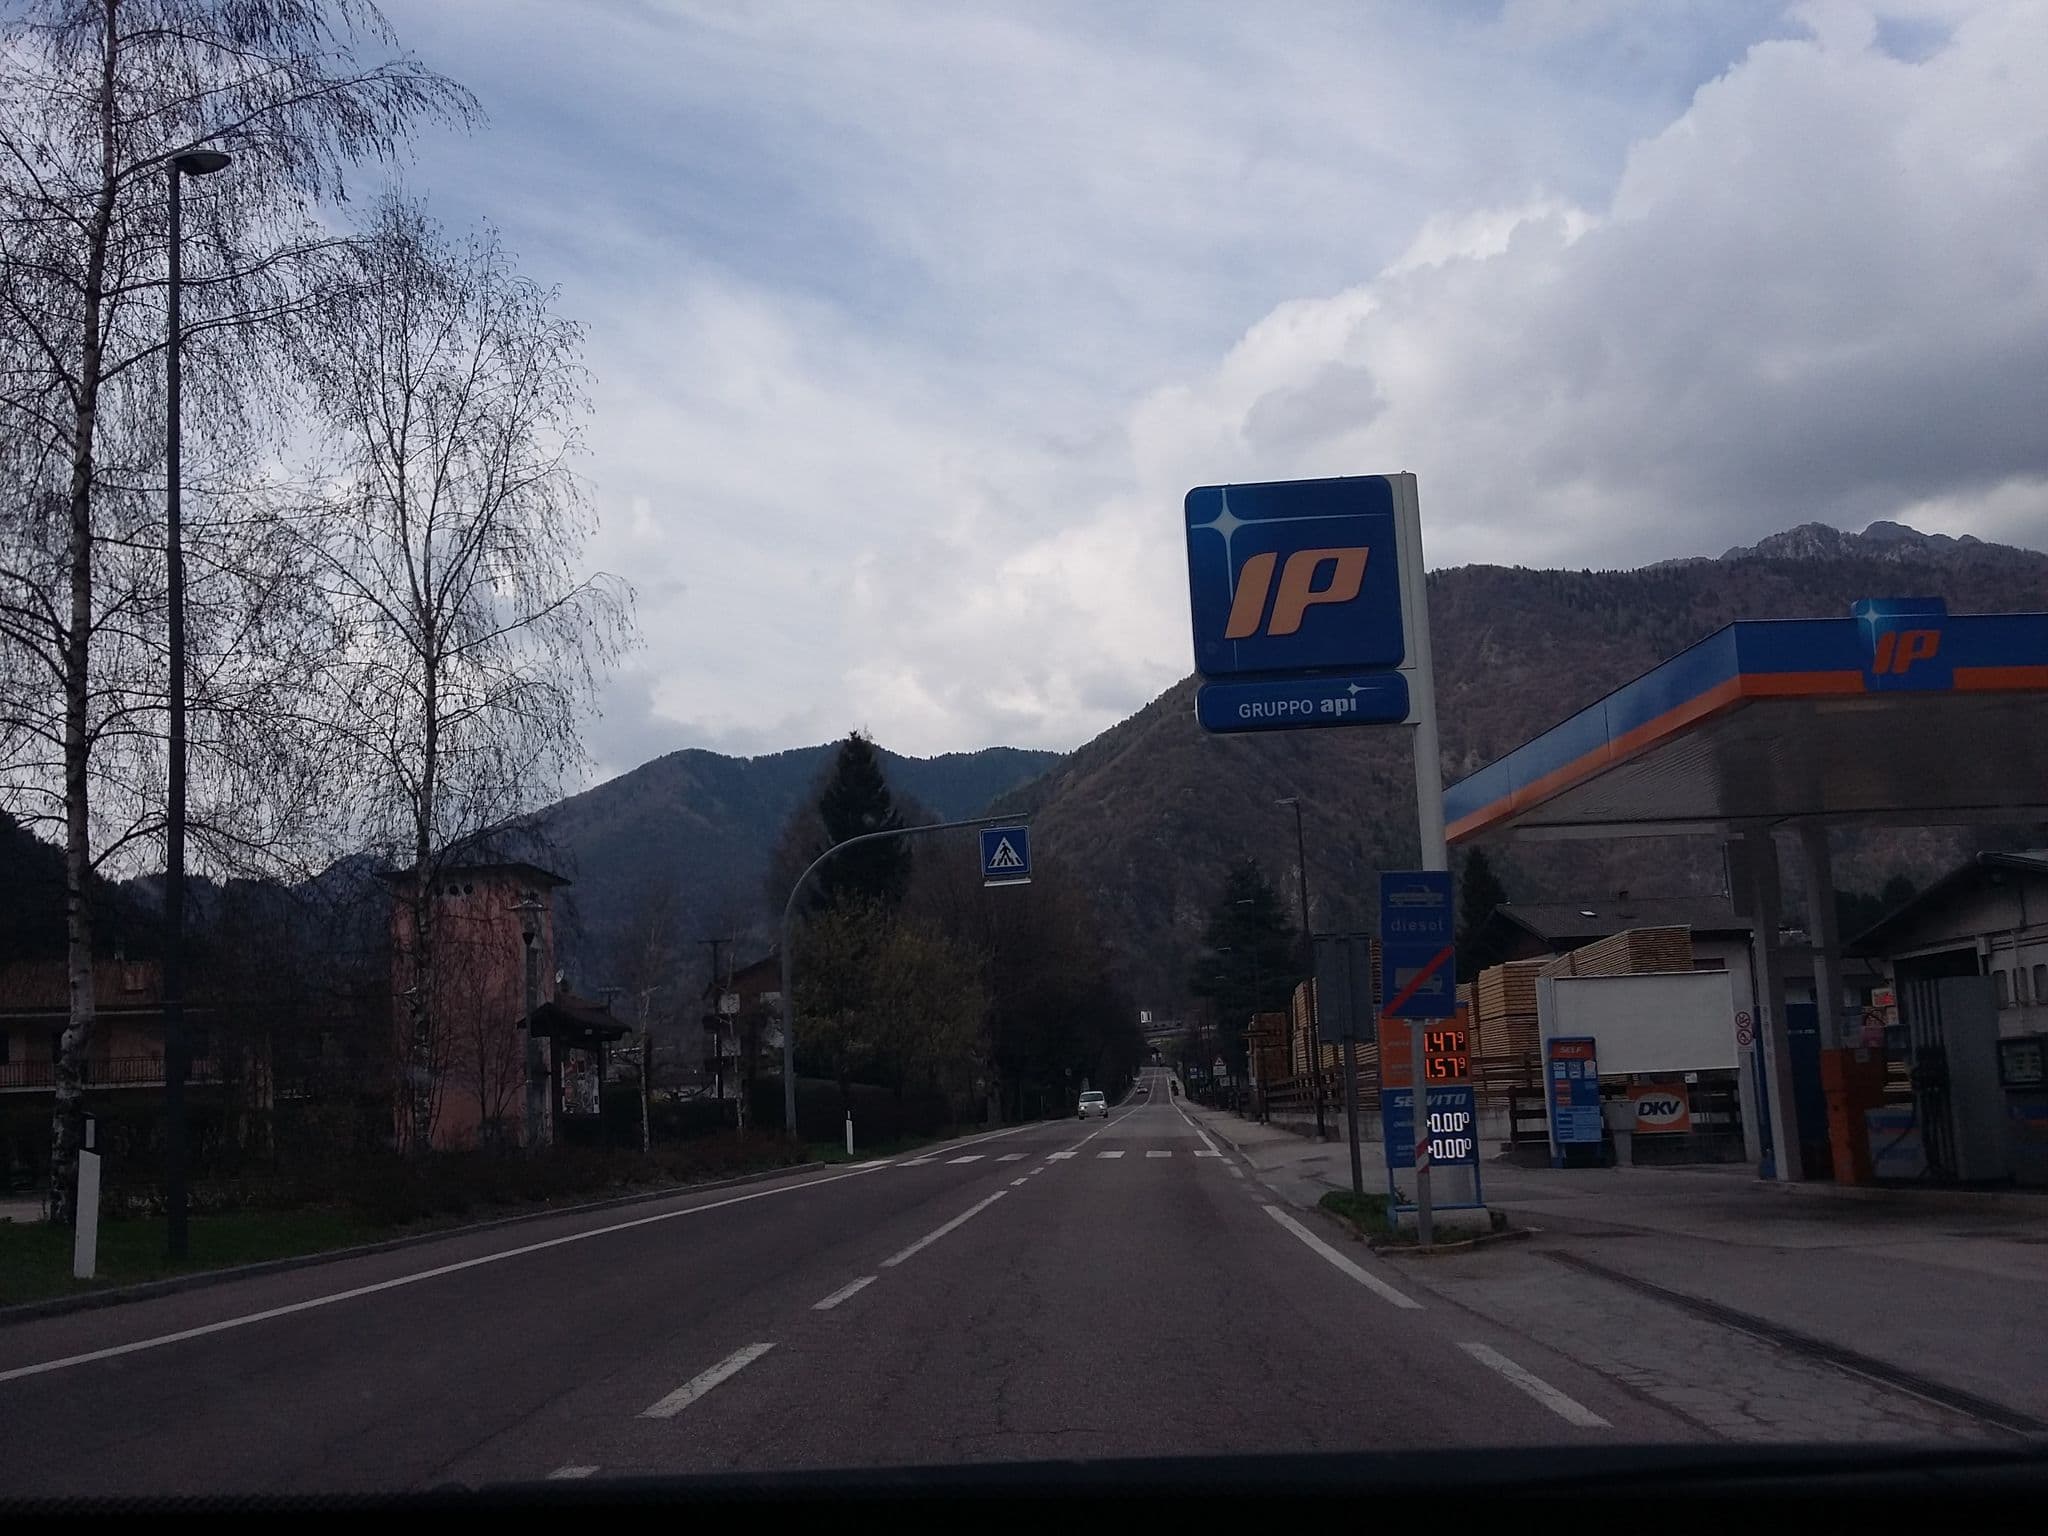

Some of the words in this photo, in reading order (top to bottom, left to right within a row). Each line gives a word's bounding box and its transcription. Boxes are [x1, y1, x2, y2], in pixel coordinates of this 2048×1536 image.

[1224, 547, 1370, 640] IP
[1872, 629, 1942, 675] IP
[1238, 699, 1314, 719] GRUPPO
[1320, 696, 1357, 717] api
[1391, 917, 1444, 932] diesel
[1559, 1045, 1584, 1054] SELF
[1392, 1093, 1467, 1108] SEVITO
[1638, 1100, 1680, 1116] DKV
